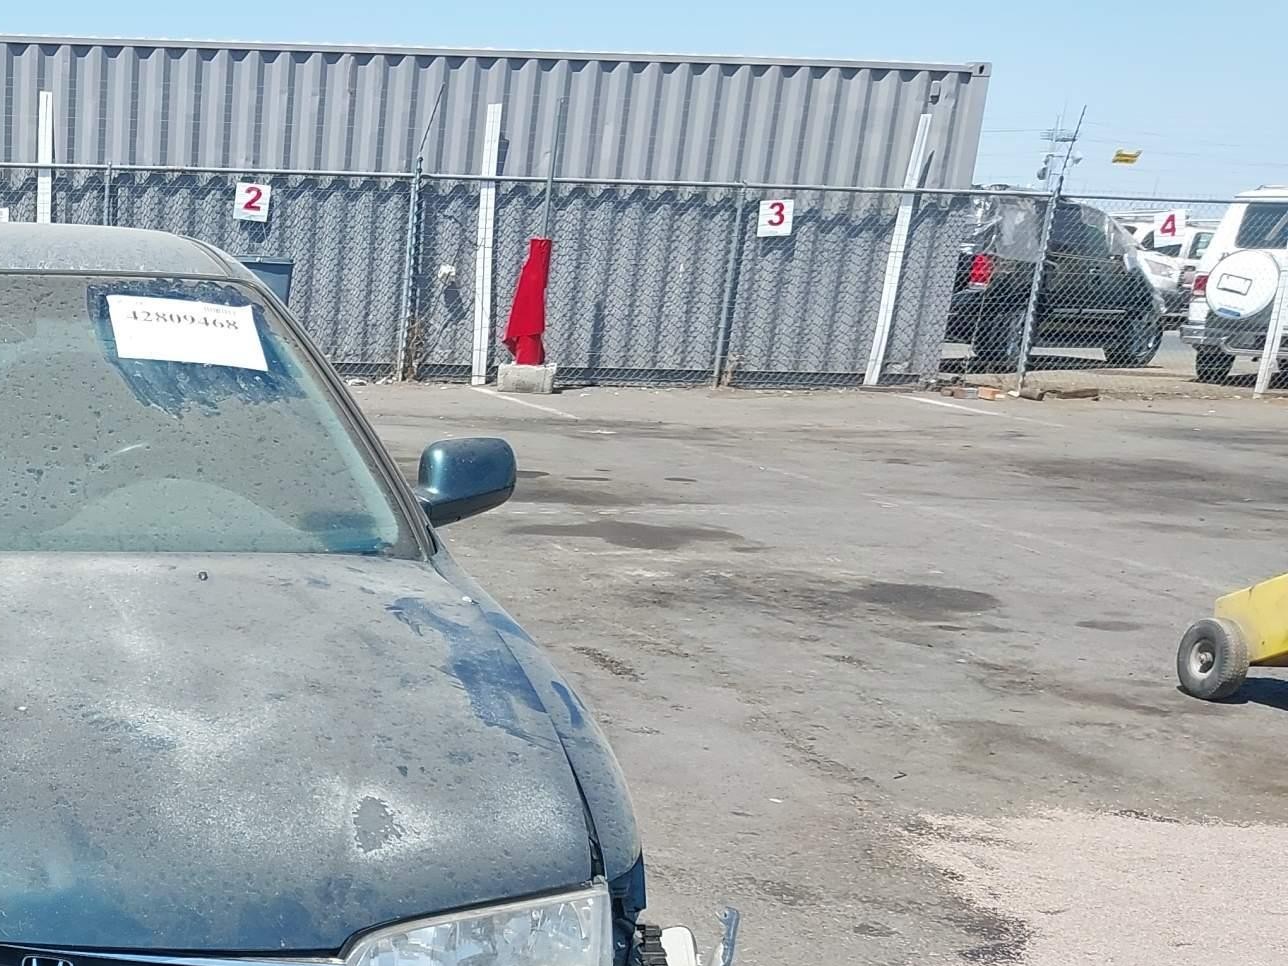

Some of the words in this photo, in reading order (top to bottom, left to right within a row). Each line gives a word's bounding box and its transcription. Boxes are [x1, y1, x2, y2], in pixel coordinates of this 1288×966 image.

[243, 187, 263, 212] 2
[768, 202, 785, 227] 3
[1159, 213, 1177, 237] 4
[126, 310, 240, 331] 42809468
